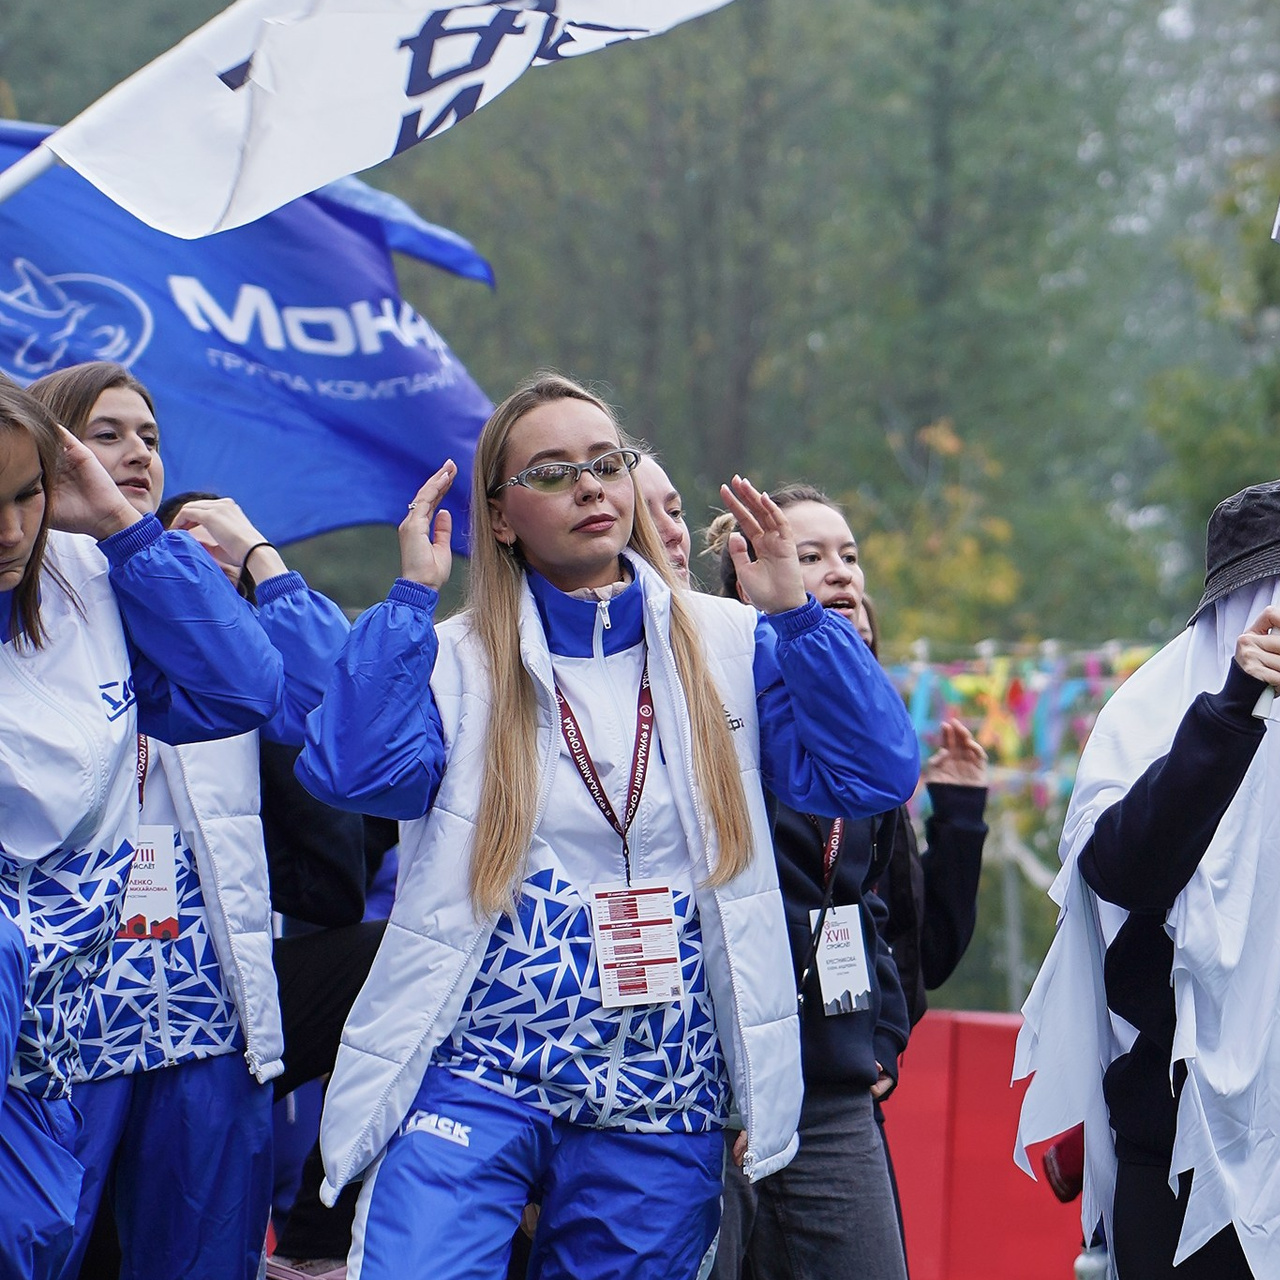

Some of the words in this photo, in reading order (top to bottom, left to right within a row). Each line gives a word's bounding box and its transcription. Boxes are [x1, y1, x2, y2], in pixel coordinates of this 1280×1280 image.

[562, 716, 583, 754] ГОРОДА
[634, 731, 649, 789] ФУНДАМЕНТ
[575, 753, 606, 810] ФУНДАМЕНТ
[605, 809, 612, 817] Я
[825, 928, 850, 943] XVIII
